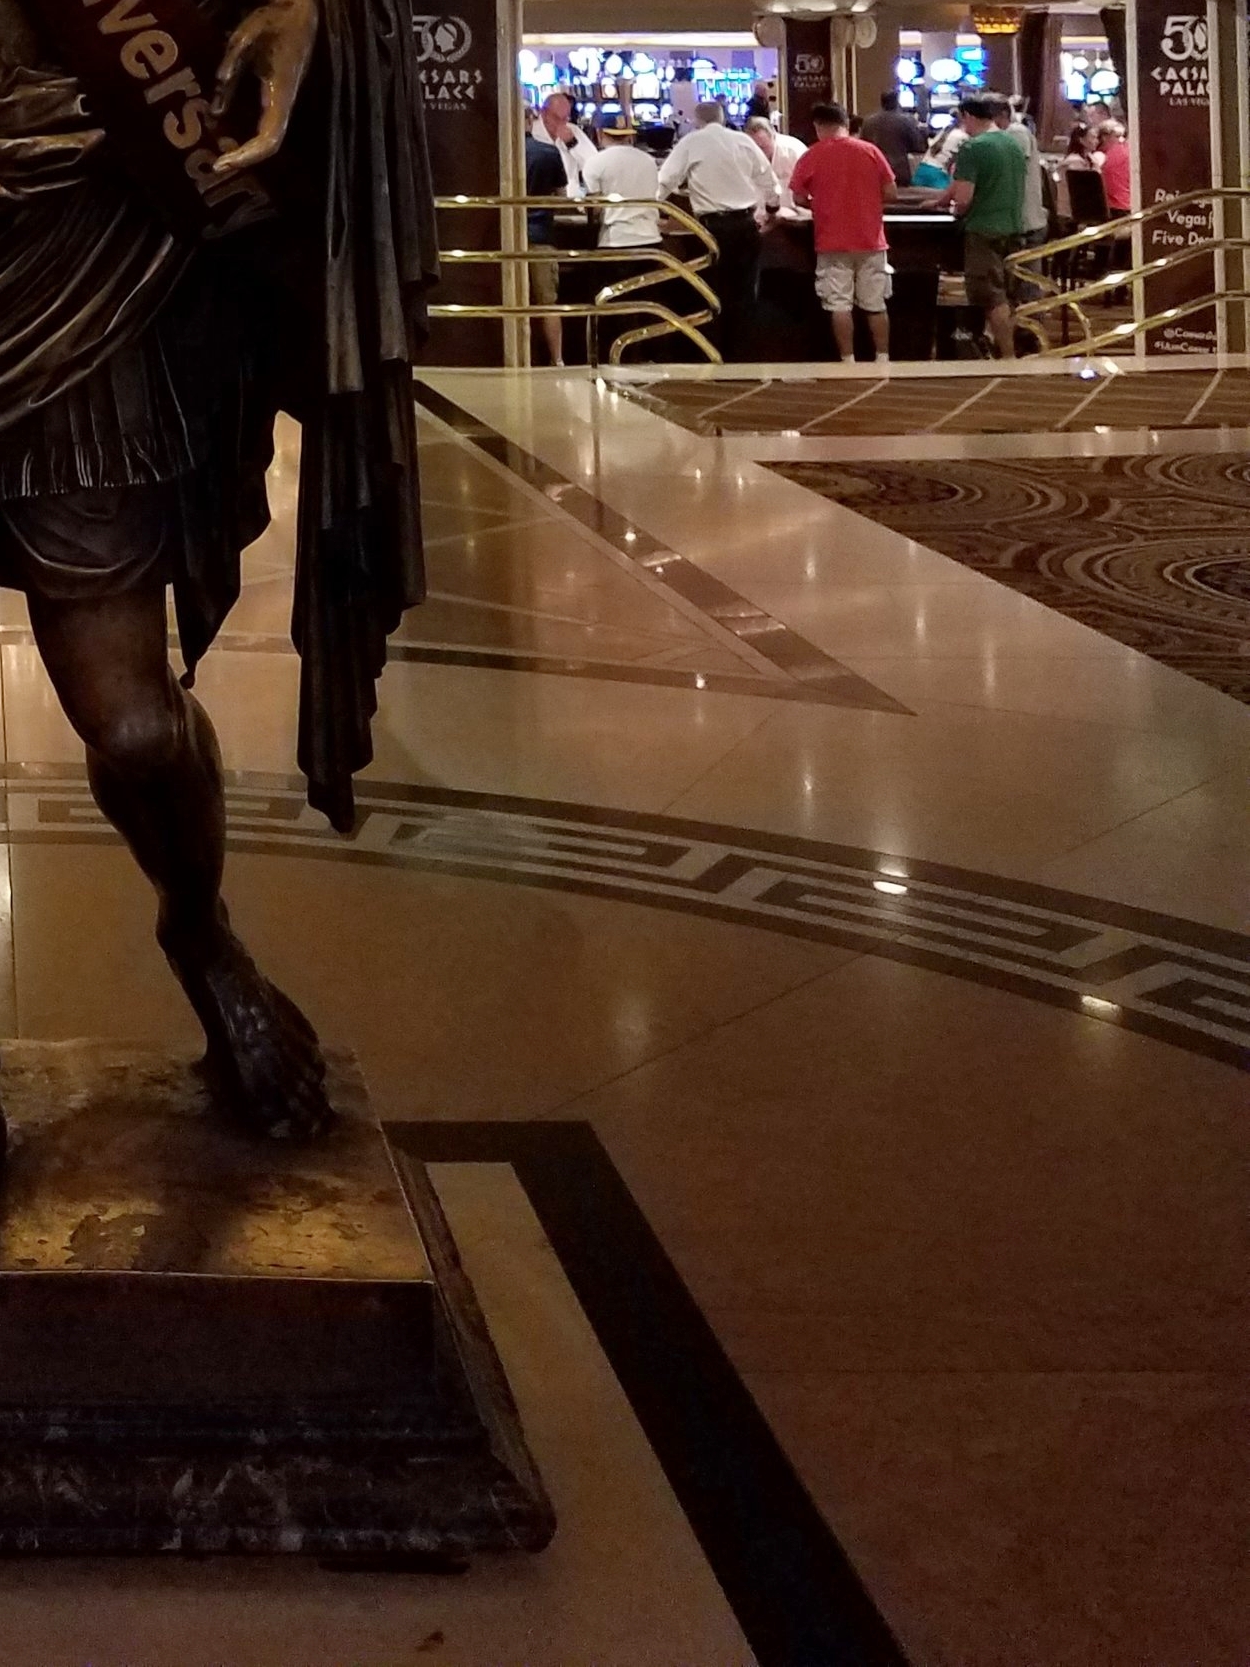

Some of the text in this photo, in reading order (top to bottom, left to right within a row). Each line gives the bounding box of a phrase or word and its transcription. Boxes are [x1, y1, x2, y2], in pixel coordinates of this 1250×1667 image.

[418, 69, 483, 84] ESARS
[1150, 66, 1208, 81] CAESA
[424, 85, 475, 100] LACE
[1166, 209, 1207, 229] Vegas
[1152, 229, 1185, 245] Five
